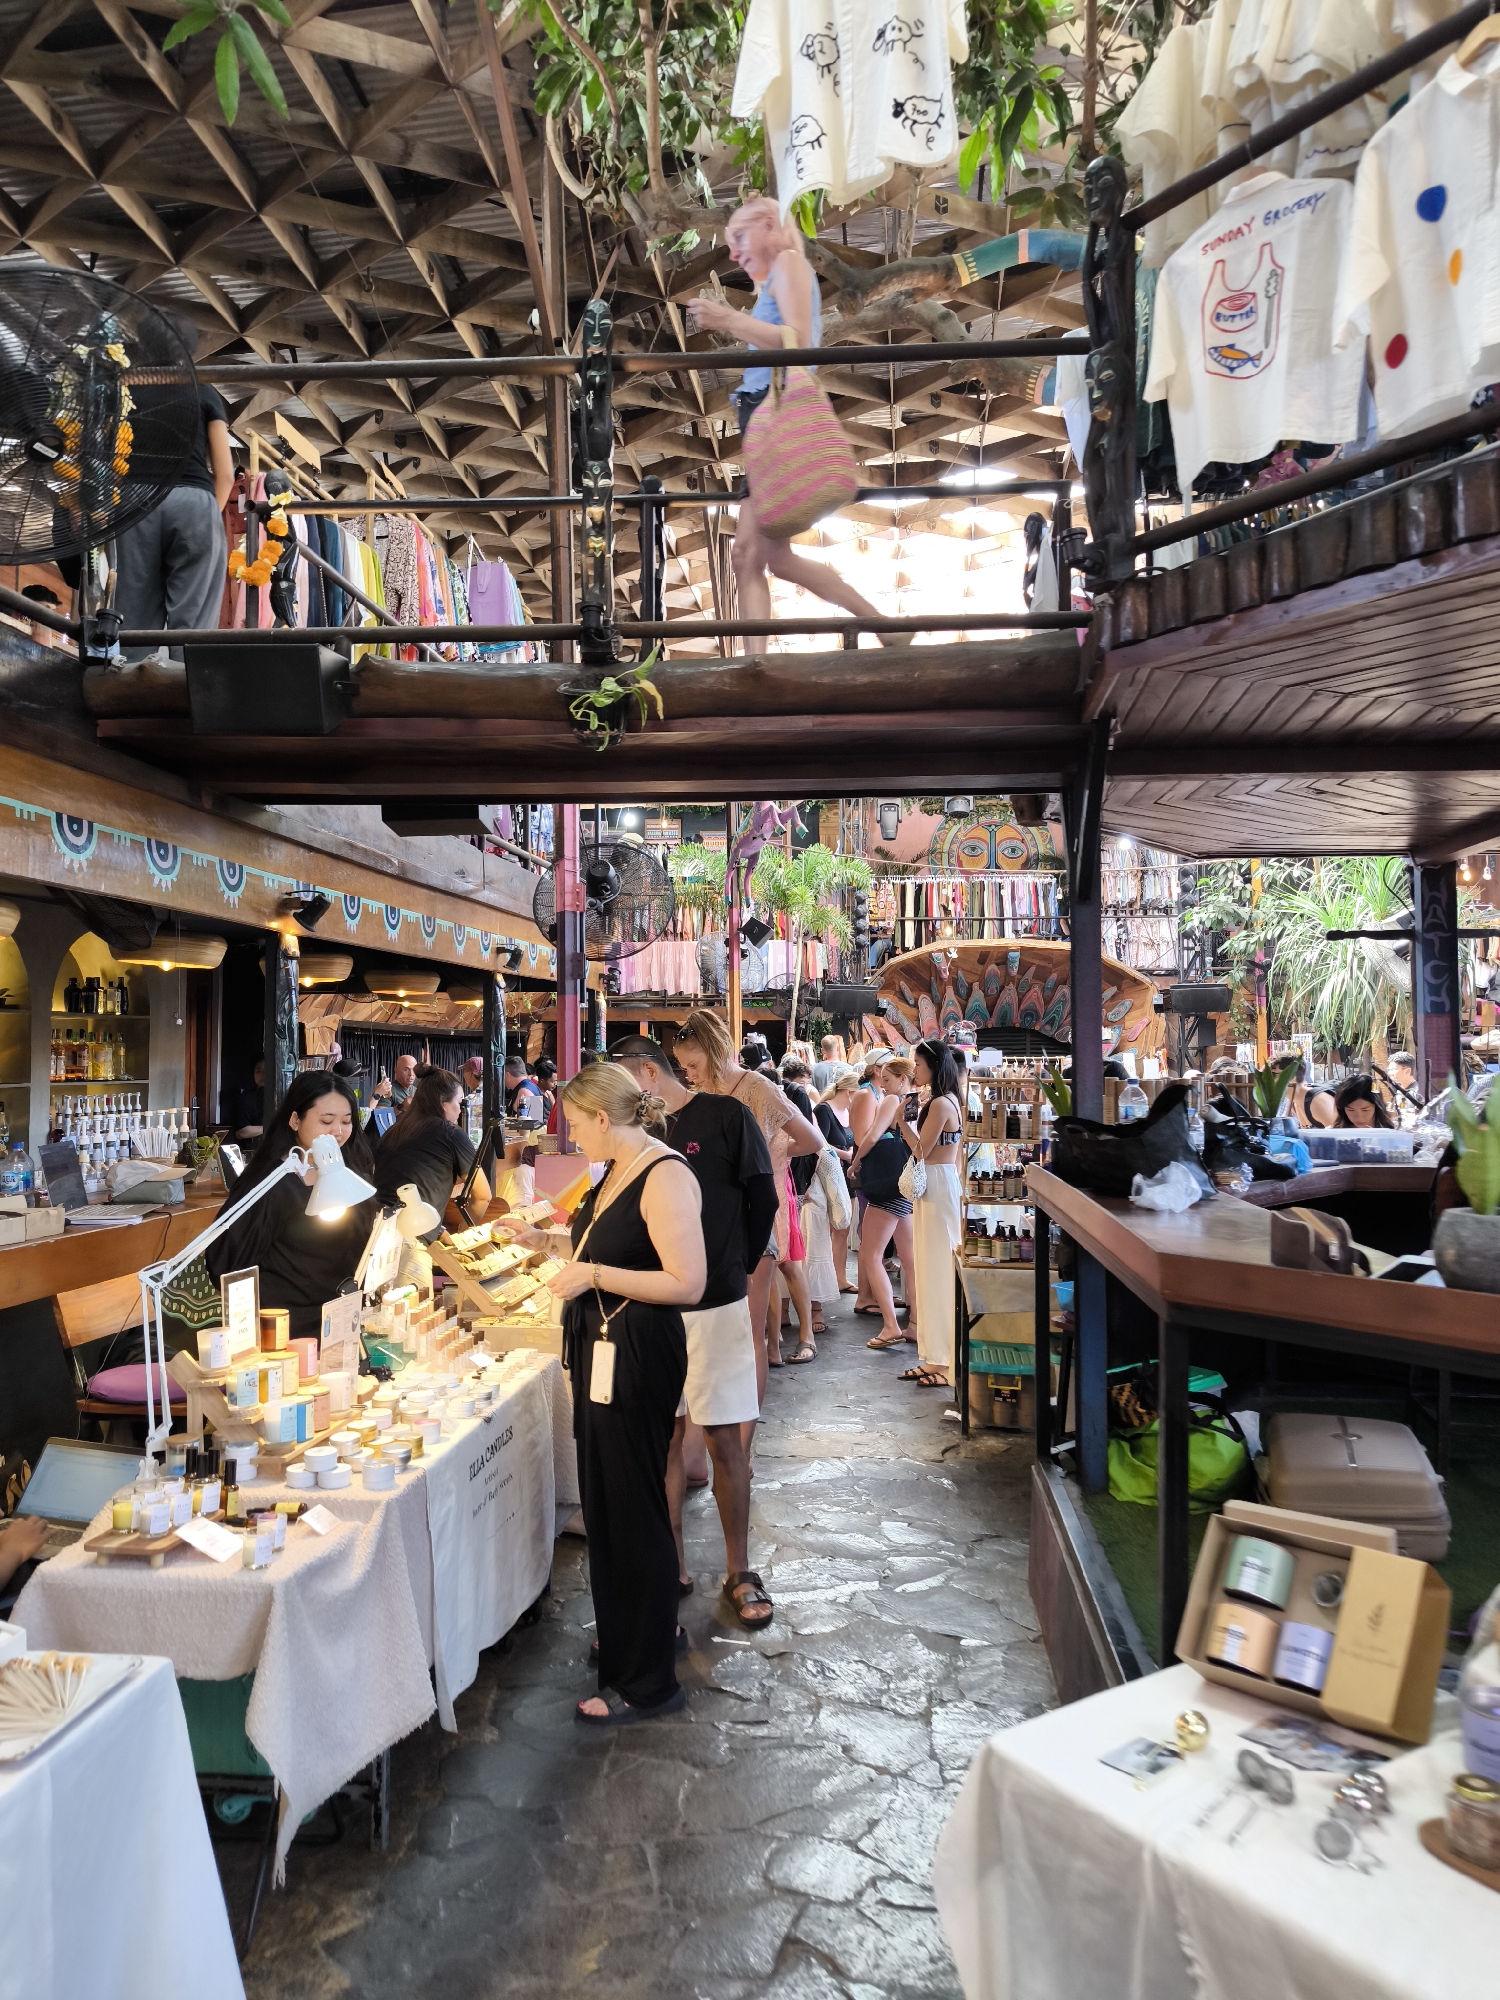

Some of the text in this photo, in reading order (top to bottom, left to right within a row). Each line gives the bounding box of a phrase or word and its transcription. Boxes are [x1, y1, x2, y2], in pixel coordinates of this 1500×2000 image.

[1201, 191, 1326, 256] SUNDAY GROCERY
[1215, 306, 1256, 323] BUTTER
[1422, 876, 1452, 1013] HATCH
[469, 1425, 514, 1482] ELLA CANDLES
